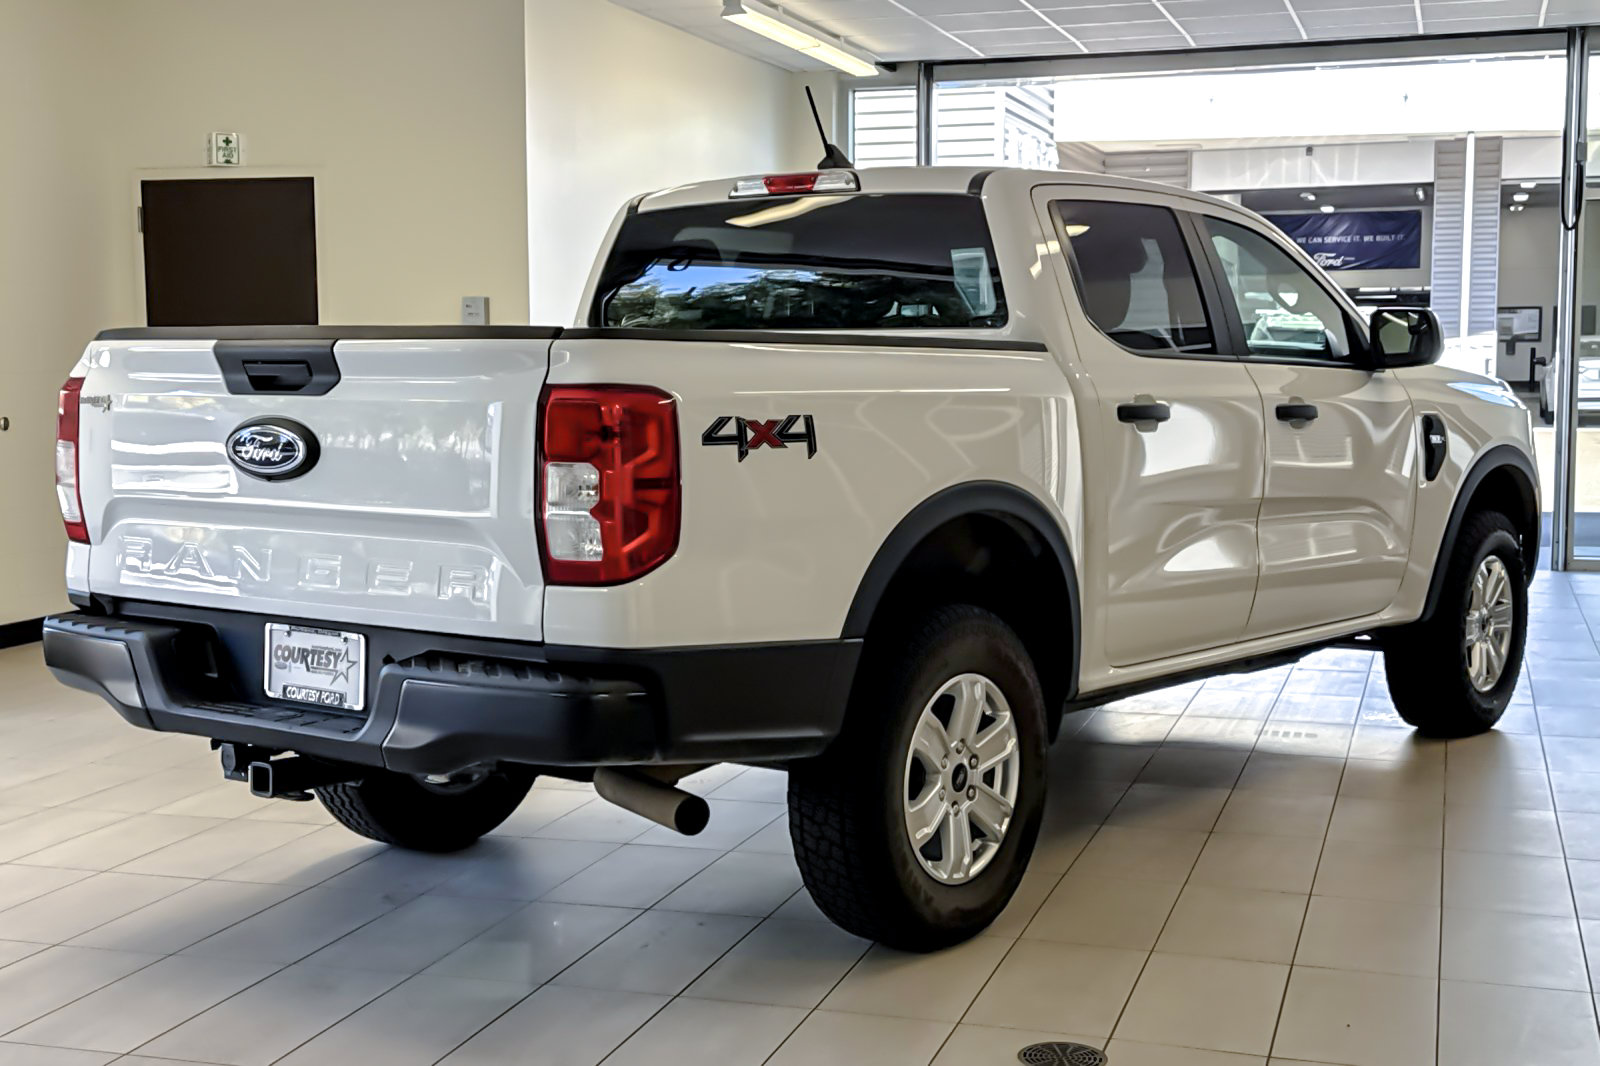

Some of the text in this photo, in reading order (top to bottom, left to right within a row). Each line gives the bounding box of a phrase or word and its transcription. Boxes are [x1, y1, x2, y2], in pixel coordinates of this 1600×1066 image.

[1308, 236, 1322, 244] CAN
[1323, 235, 1351, 244] SERVICE
[1363, 234, 1374, 242] WE
[1375, 234, 1395, 242] BUILT
[1313, 252, 1344, 267] Ford
[240, 432, 283, 461] Ford
[116, 535, 490, 606] RANGER
[274, 644, 342, 672] COURTESY
[286, 687, 340, 705] COURTESY FORD
